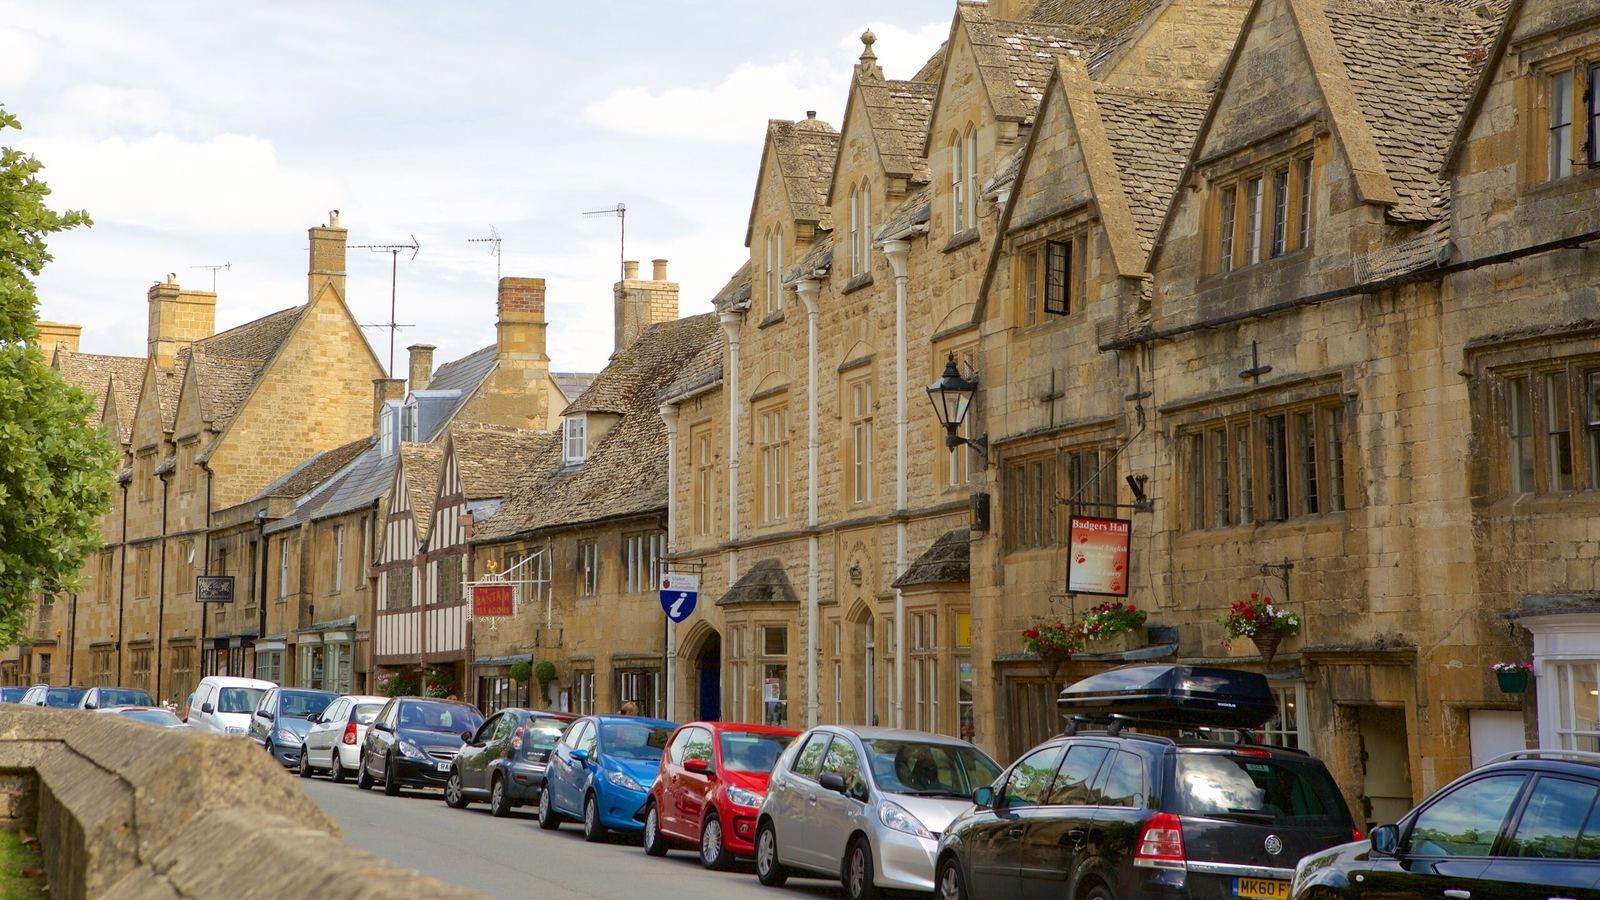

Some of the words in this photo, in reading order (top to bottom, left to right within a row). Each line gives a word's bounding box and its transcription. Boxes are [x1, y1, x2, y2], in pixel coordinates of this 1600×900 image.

[1072, 519, 1107, 531] Badgers
[1109, 523, 1128, 532] Hall
[1241, 880, 1275, 895] MK60
